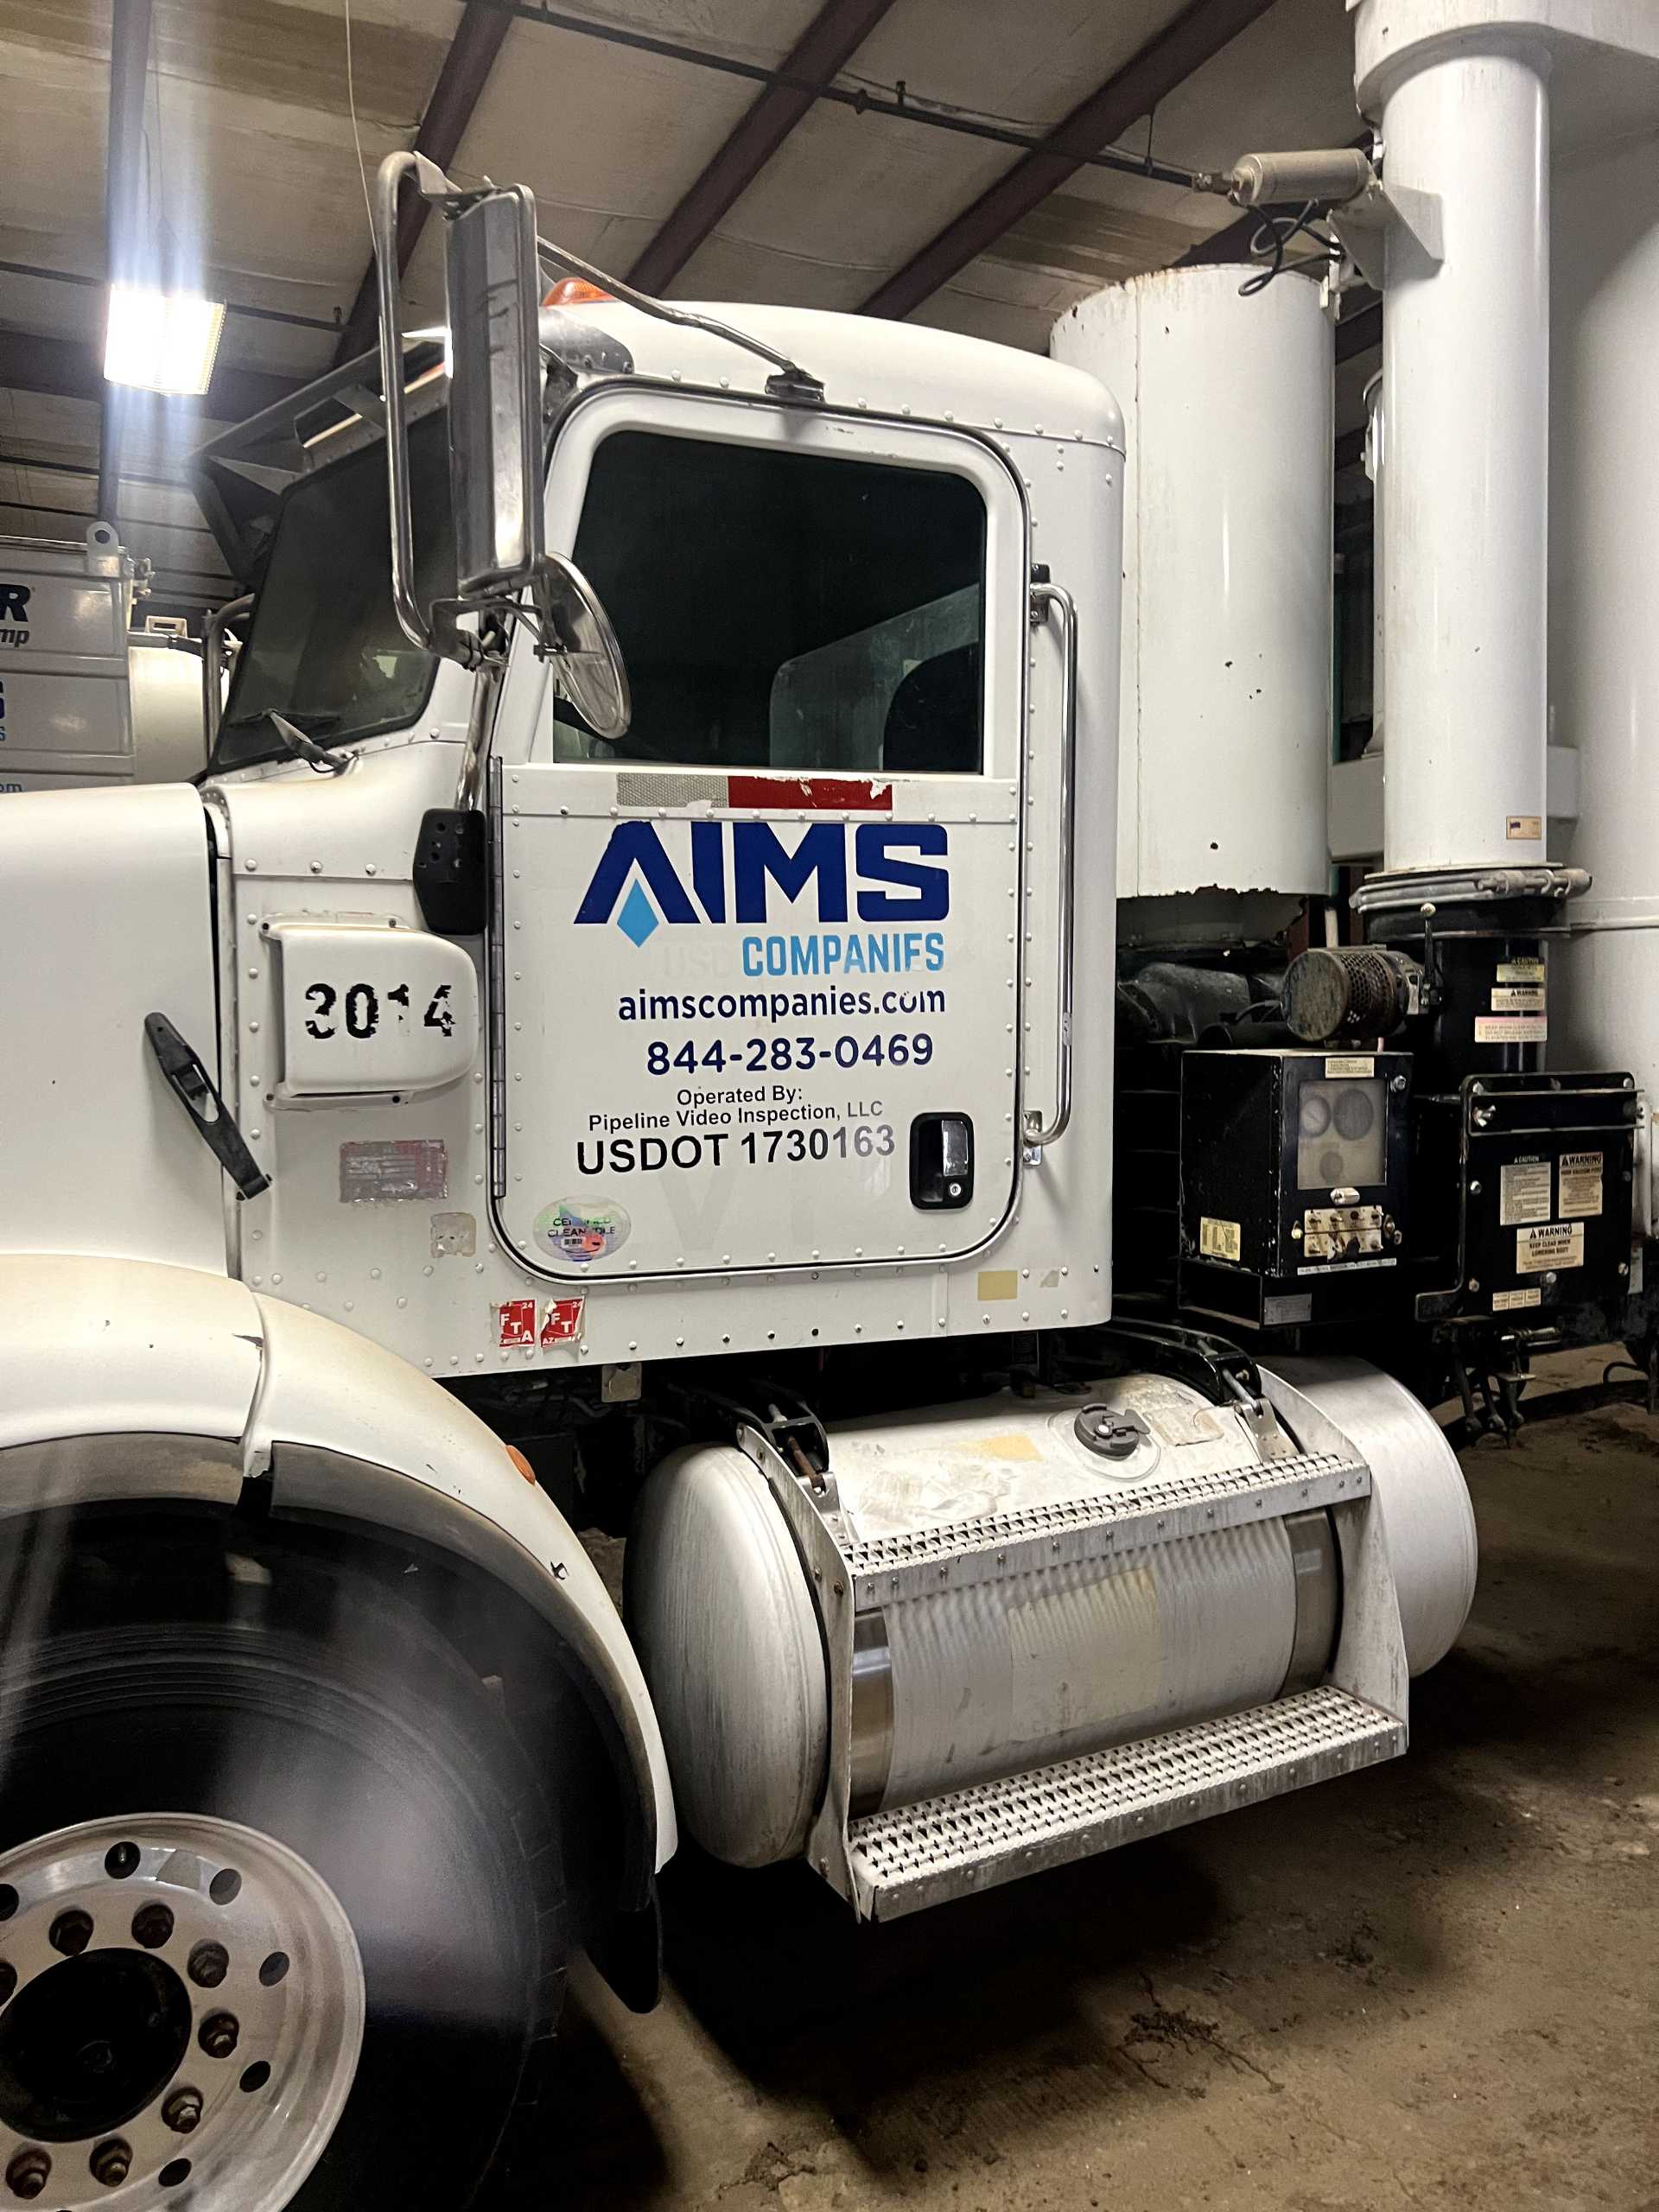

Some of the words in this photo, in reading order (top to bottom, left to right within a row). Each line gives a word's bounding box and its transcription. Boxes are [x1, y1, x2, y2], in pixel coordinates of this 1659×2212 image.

[574, 821, 950, 925] AIMS
[618, 984, 945, 1023] aimscompanies.com
[646, 1033, 933, 1076] 844-283-0469
[677, 1088, 766, 1109] Operated
[772, 1085, 803, 1104] By:
[588, 1112, 671, 1135] Pipeline
[677, 1109, 732, 1127] Video
[738, 1104, 841, 1126] Inspection,
[848, 1100, 883, 1117] LLC
[577, 1133, 728, 1175] USDOT
[741, 1124, 895, 1164] 1730163
[1568, 1153, 1601, 1166] WARNING
[1538, 1224, 1573, 1238] WARNING
